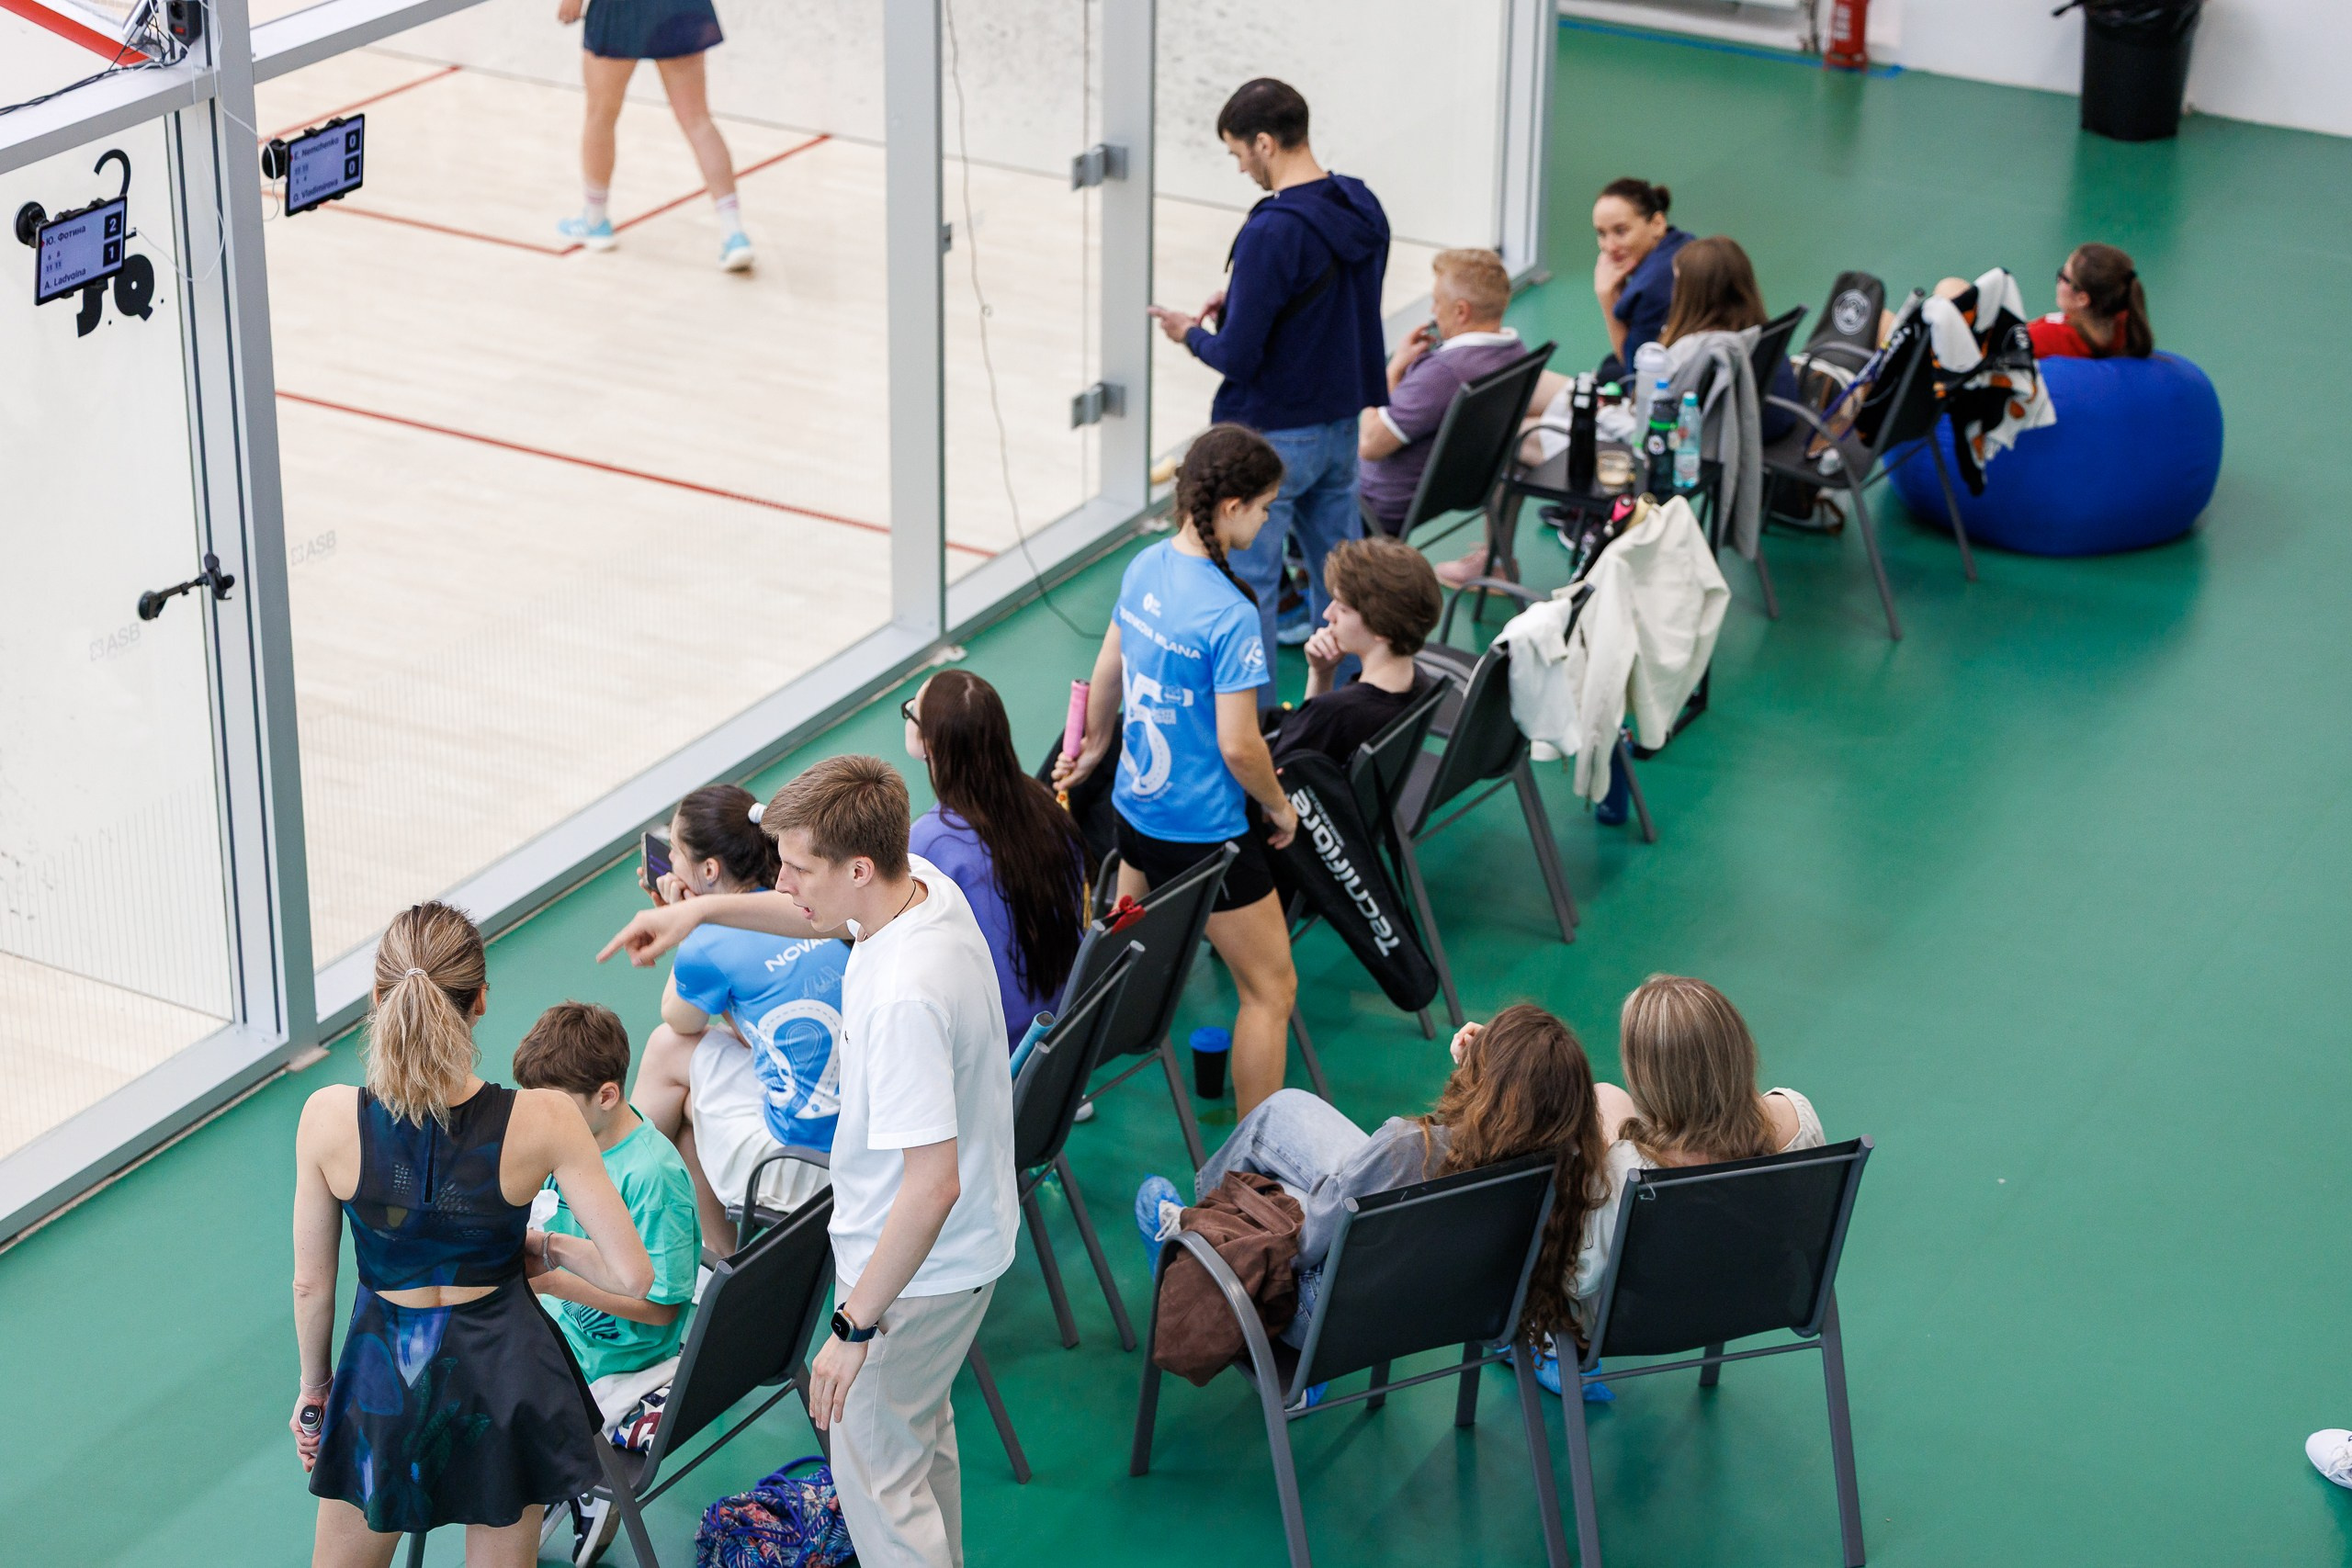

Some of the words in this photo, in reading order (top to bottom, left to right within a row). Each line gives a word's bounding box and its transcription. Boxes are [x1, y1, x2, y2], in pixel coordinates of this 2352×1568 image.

[349, 134, 356, 148] 0
[348, 161, 356, 175] 0
[57, 225, 86, 242] Фотина
[108, 218, 117, 232] 2
[108, 245, 115, 259] 1
[306, 530, 336, 559] ASB
[106, 622, 141, 655] ASB
[1290, 788, 1400, 957] Tecnifibre
[764, 937, 832, 973] NOVA
